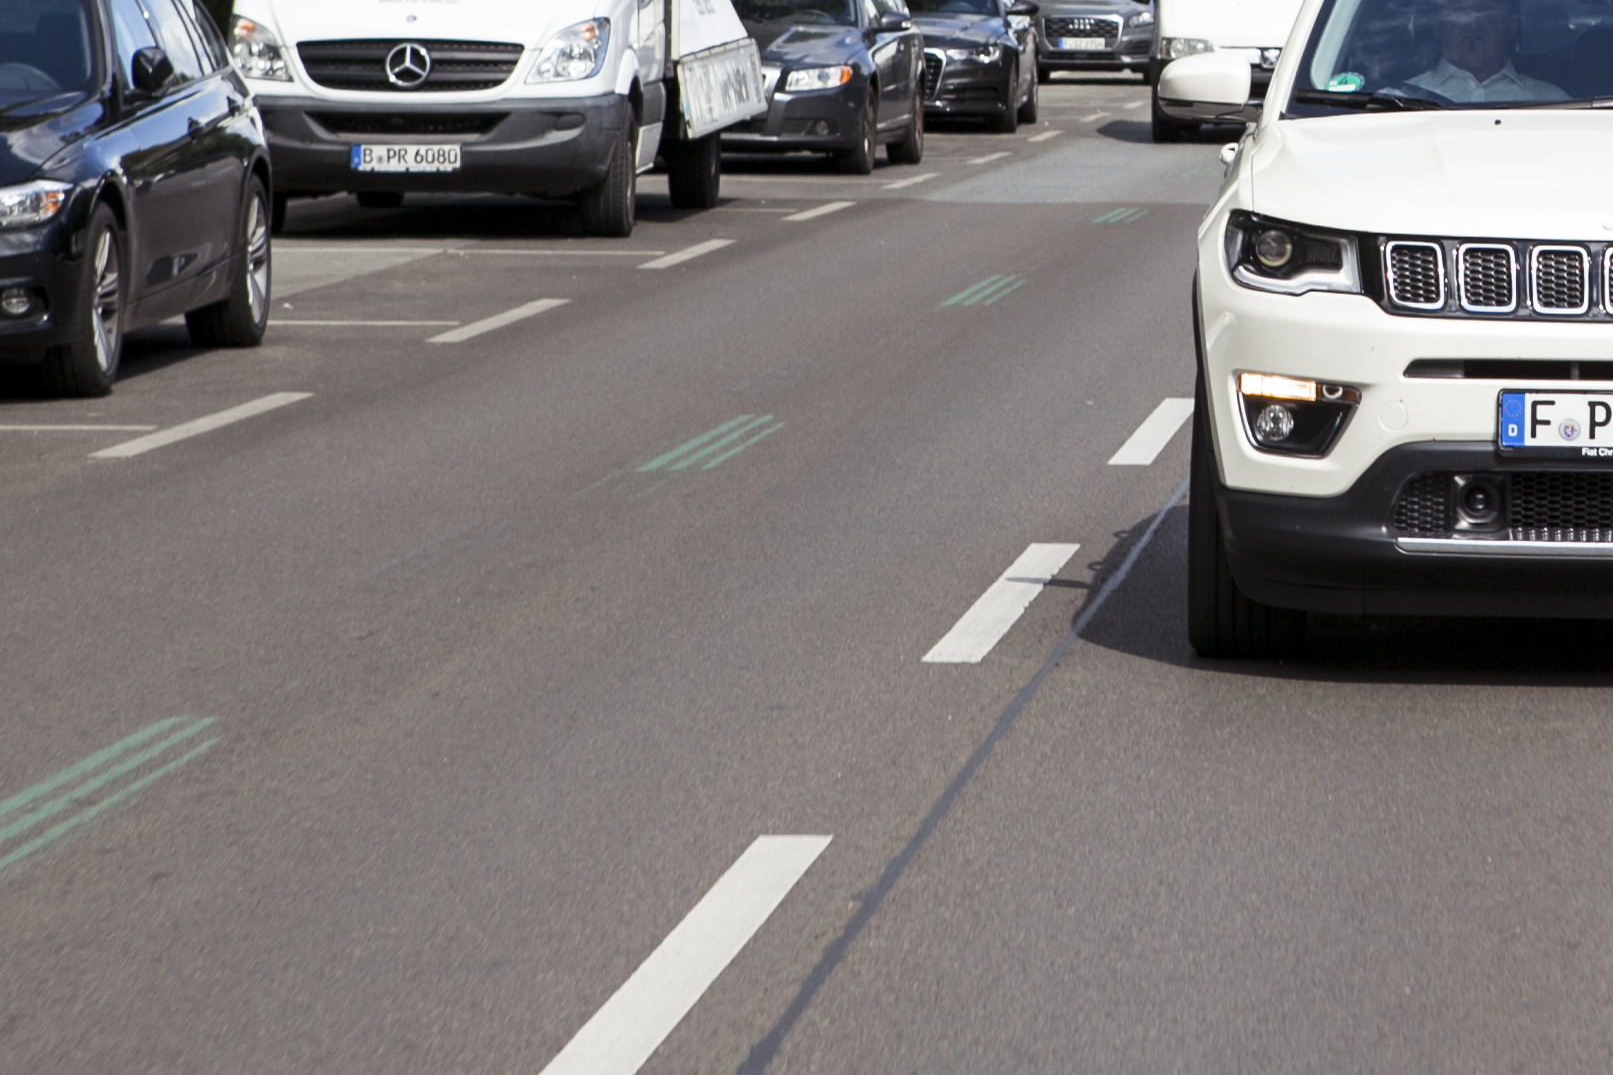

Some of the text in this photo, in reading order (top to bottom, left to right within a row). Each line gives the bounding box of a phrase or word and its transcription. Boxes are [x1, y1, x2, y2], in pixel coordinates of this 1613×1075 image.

[363, 148, 458, 165] B PR 6080
[1530, 400, 1556, 439] F
[1508, 424, 1518, 437] D
[1581, 448, 1597, 456] Fiat
